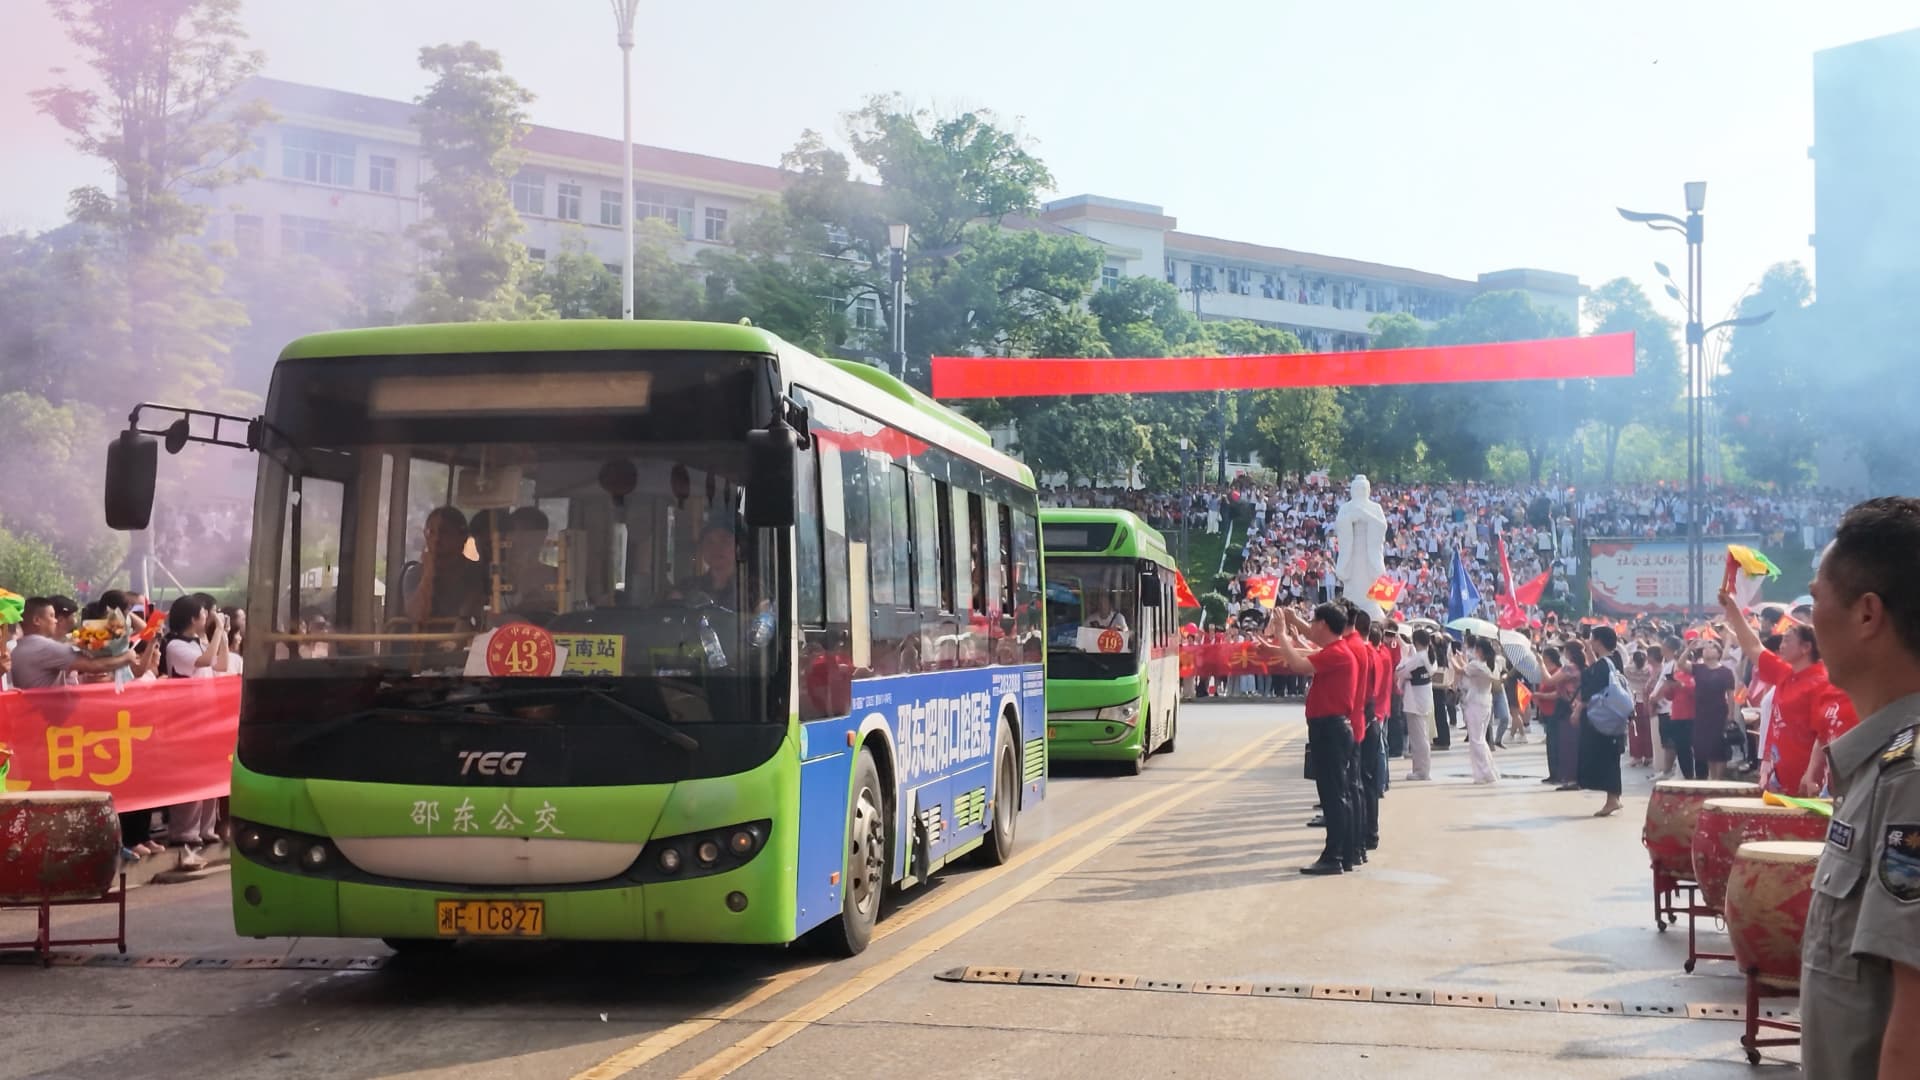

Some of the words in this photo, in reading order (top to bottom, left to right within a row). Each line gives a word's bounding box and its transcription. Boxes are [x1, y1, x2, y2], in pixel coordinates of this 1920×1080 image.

[505, 640, 538, 672] 43
[12, 711, 152, 790] 时
[896, 689, 991, 784] 邵东昭阳口腔医院
[458, 751, 527, 775] TEG
[410, 797, 565, 835] 邵东公交
[1888, 829, 1903, 846] 保
